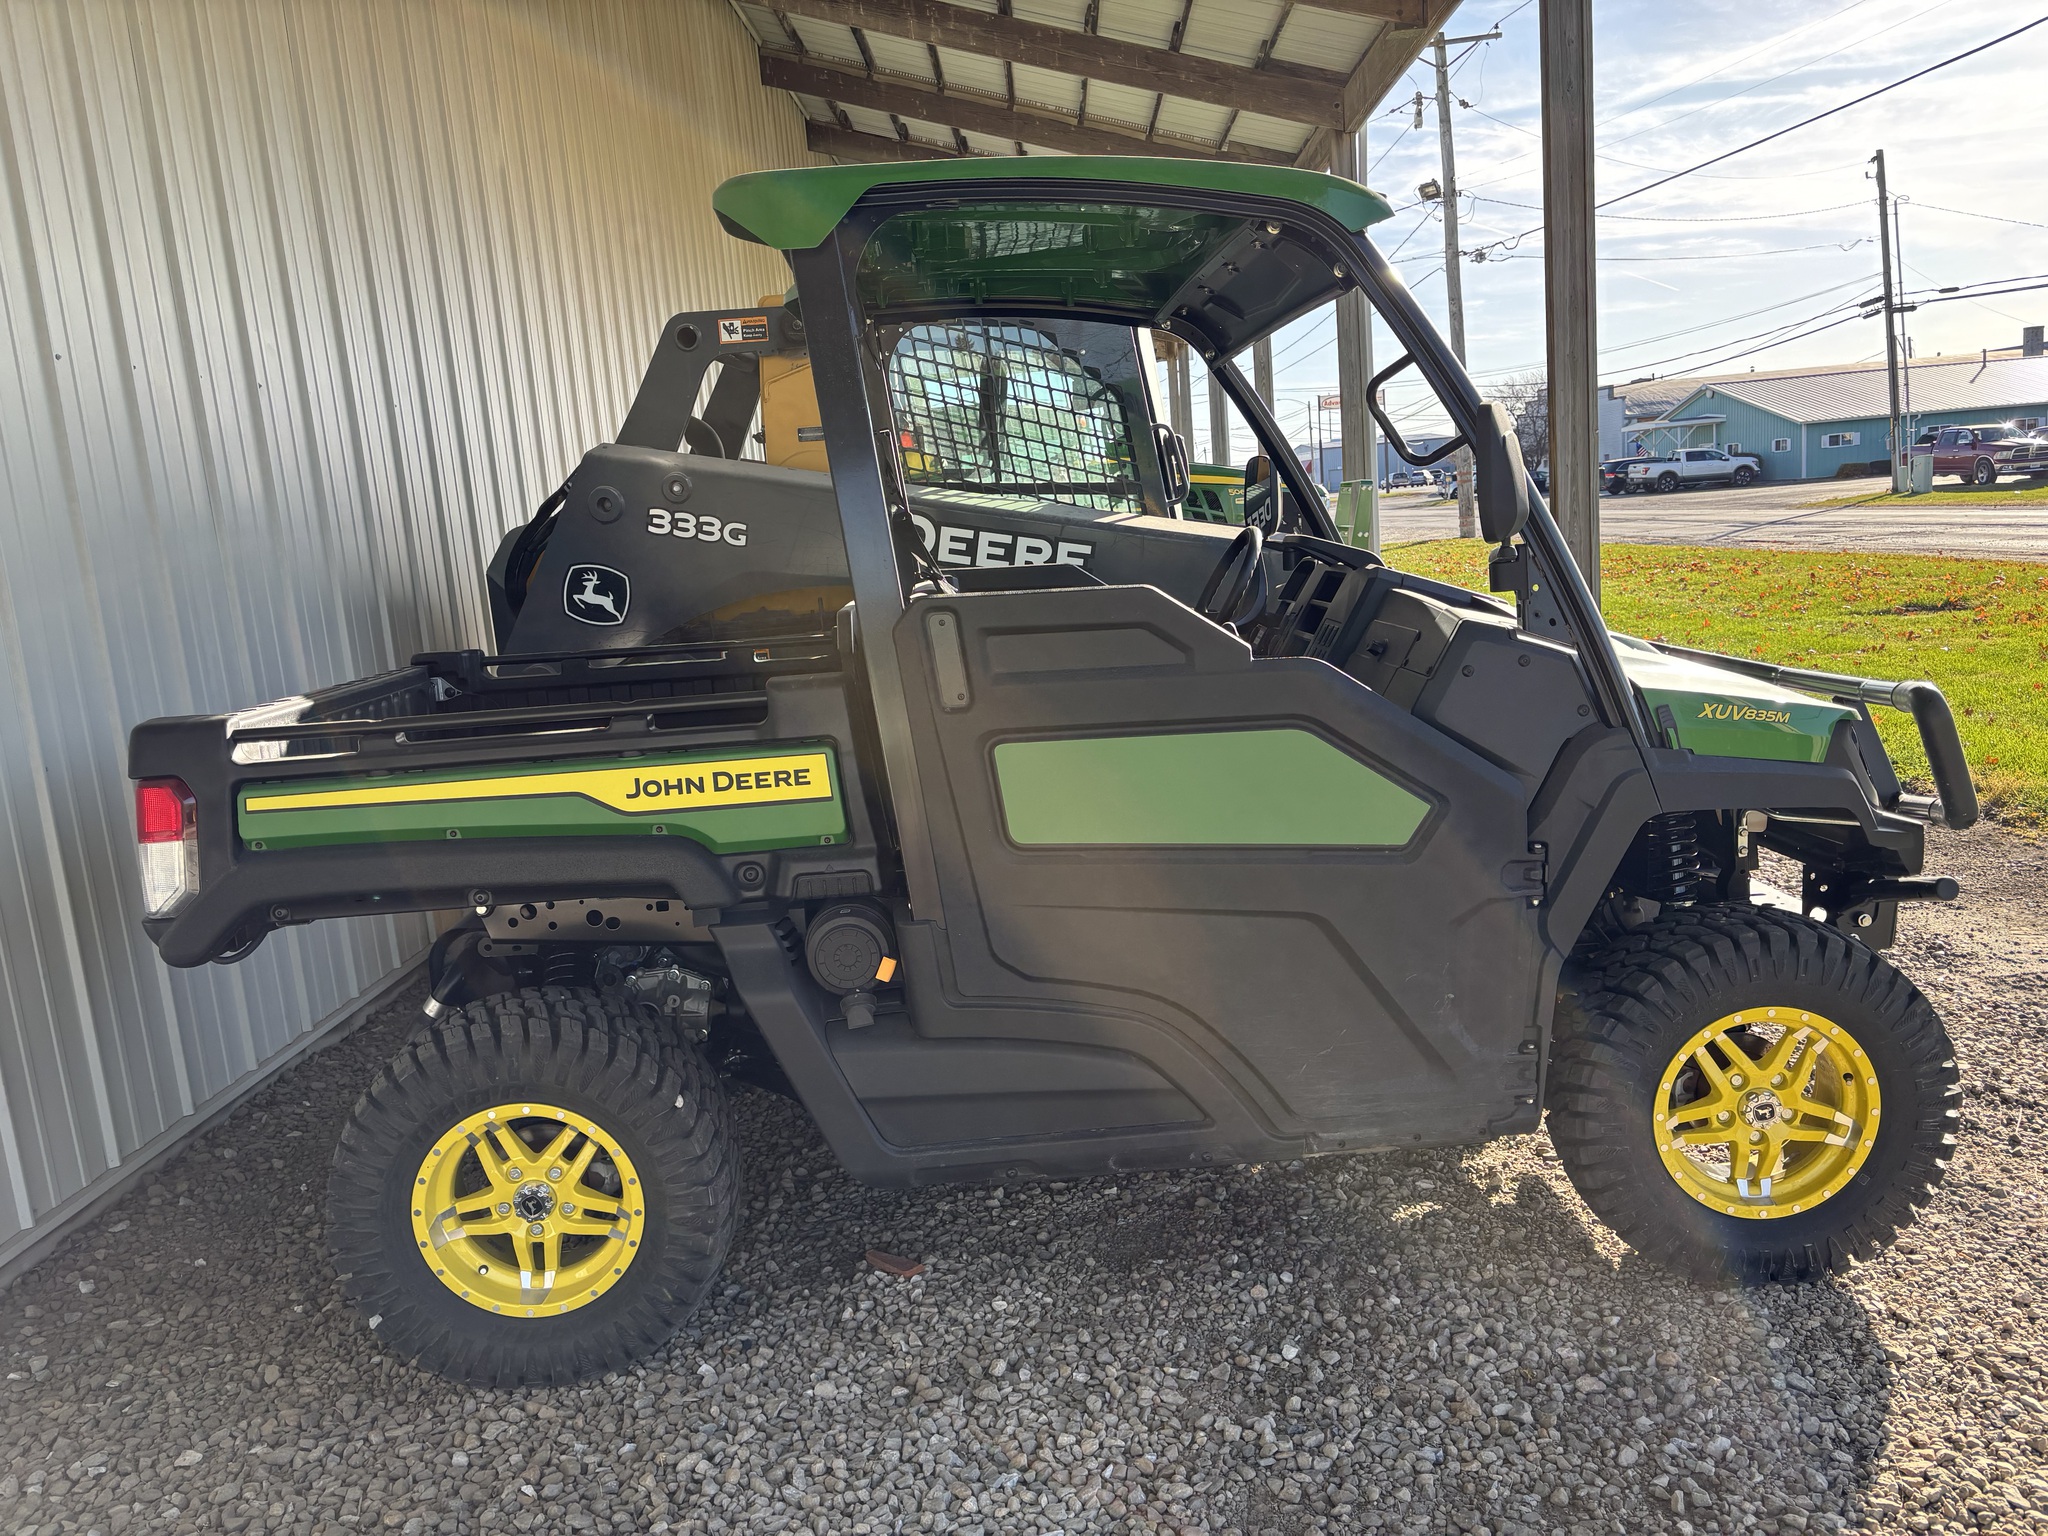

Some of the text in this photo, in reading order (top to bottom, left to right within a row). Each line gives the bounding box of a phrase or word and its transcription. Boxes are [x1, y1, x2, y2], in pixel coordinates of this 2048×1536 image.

[647, 508, 747, 546] 333G
[1697, 702, 1791, 723] XUV835M
[625, 768, 811, 799] JOHN DEERE
